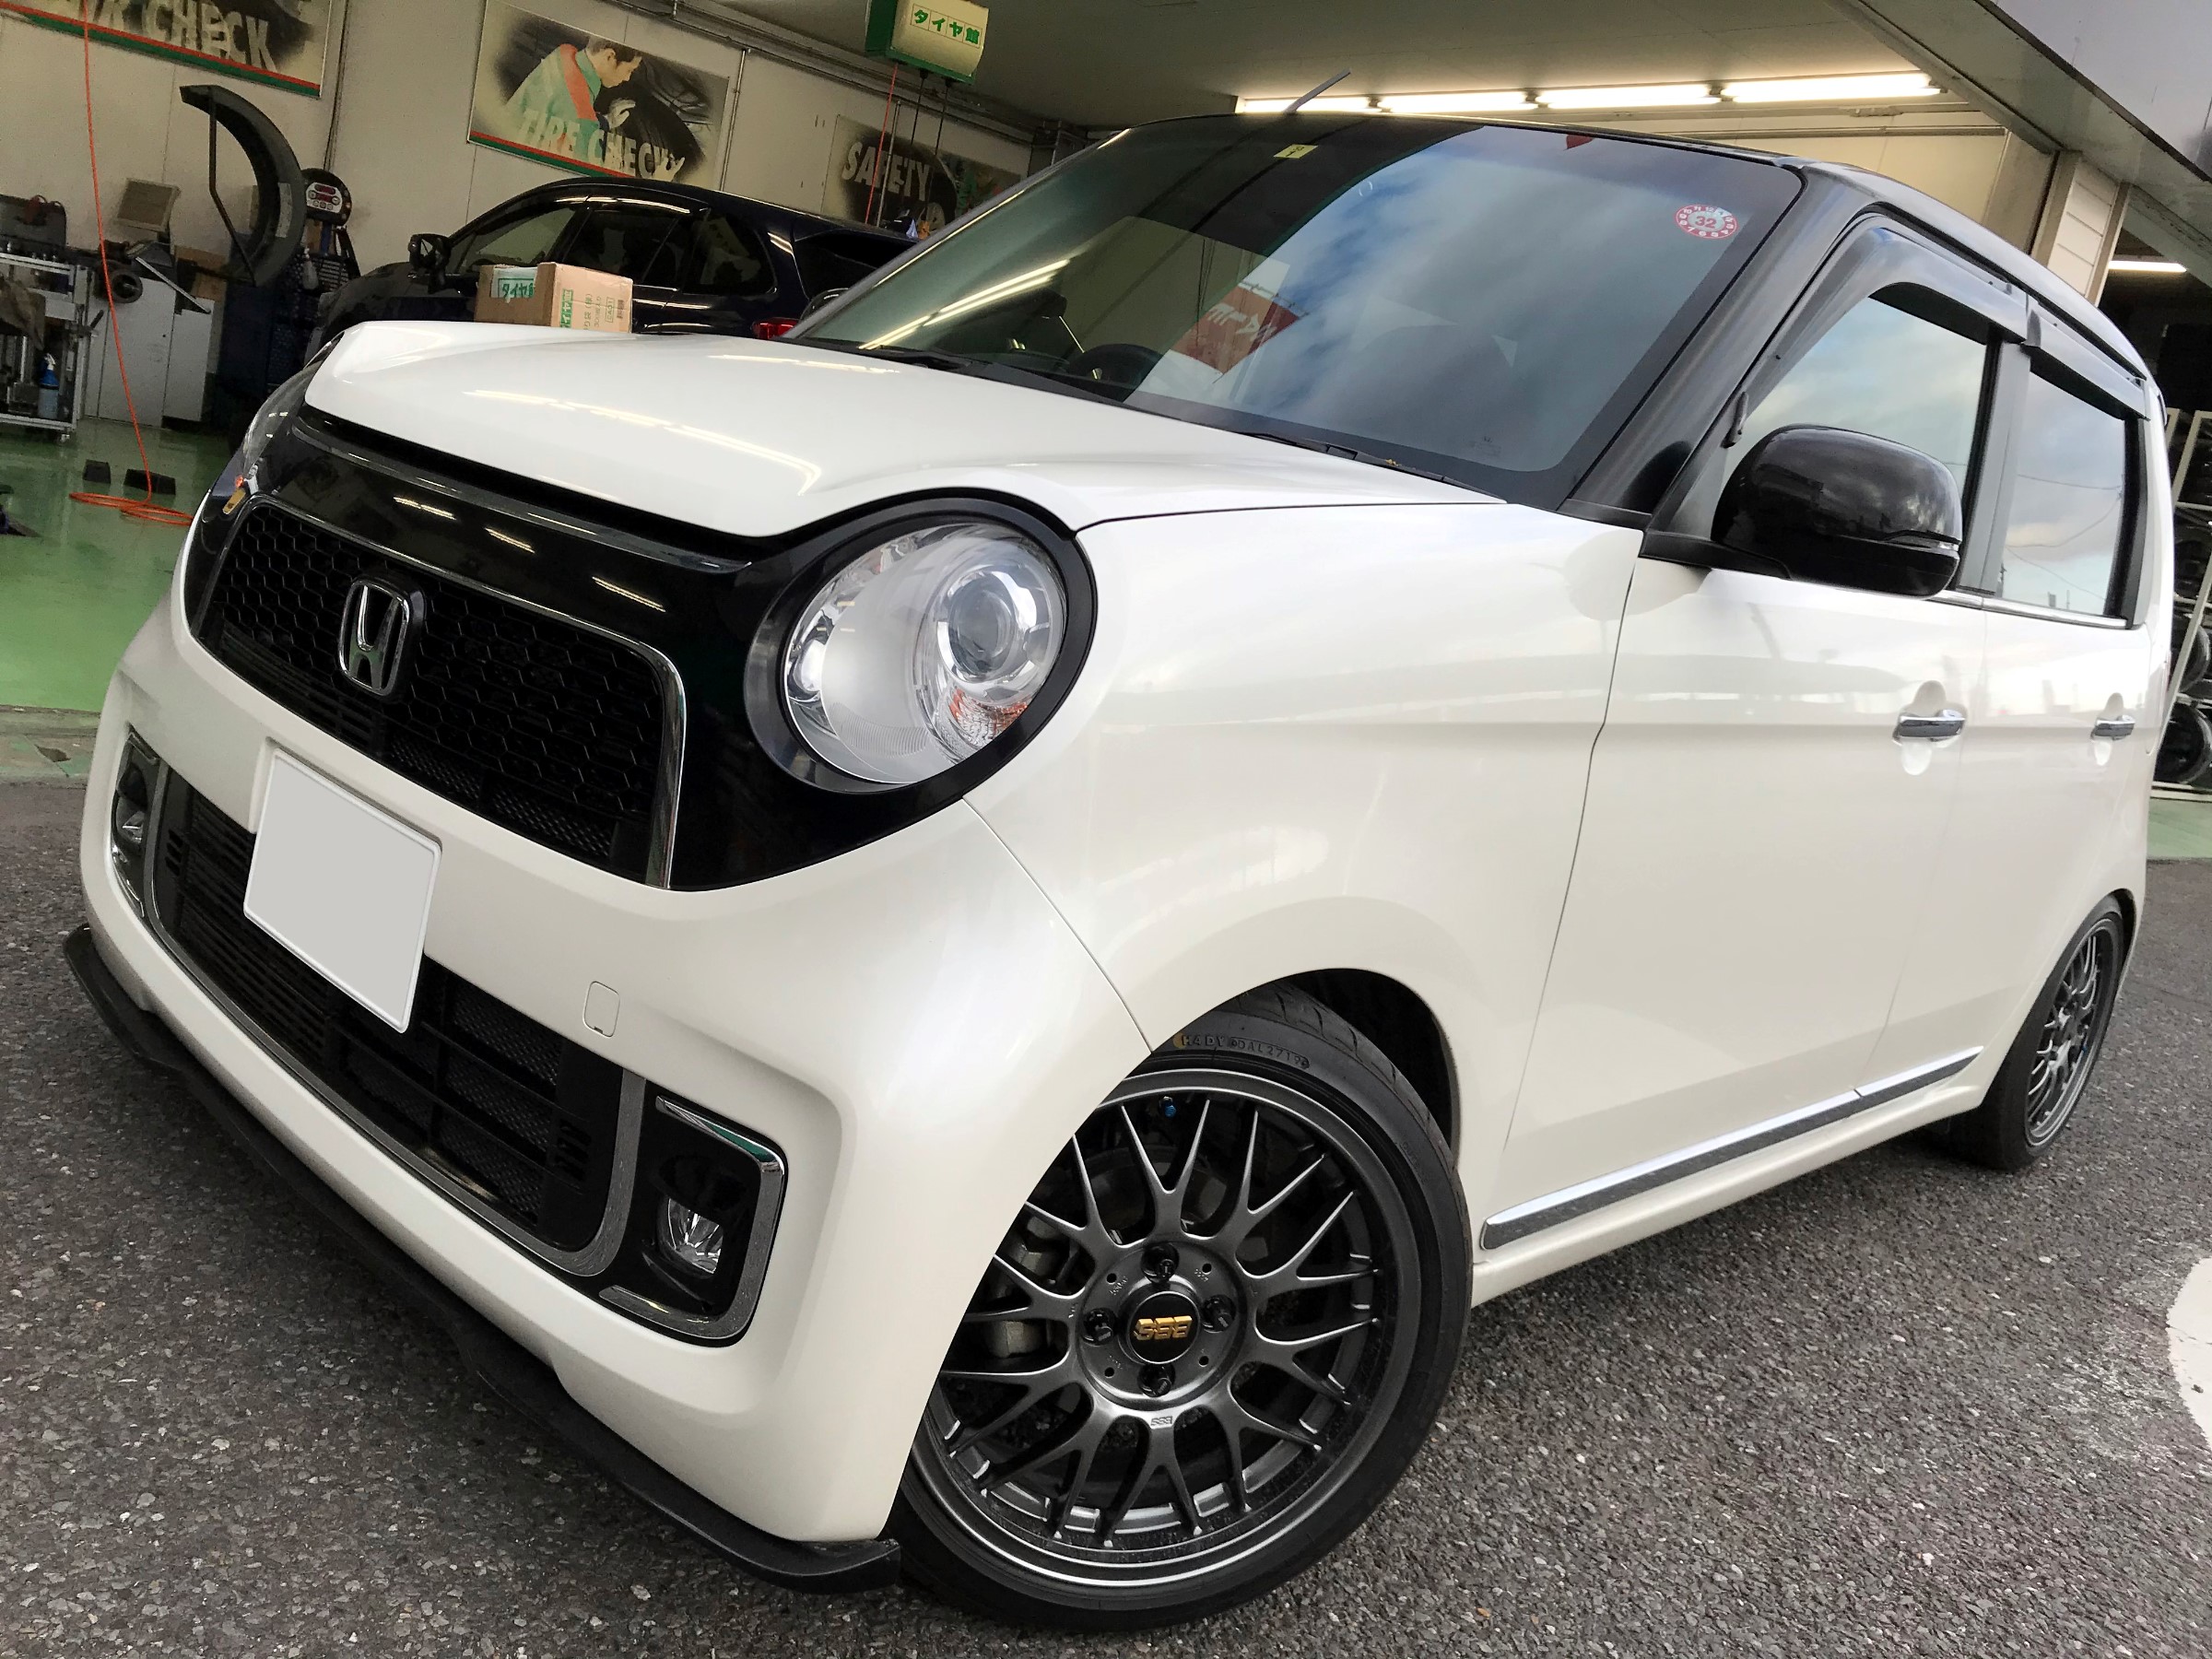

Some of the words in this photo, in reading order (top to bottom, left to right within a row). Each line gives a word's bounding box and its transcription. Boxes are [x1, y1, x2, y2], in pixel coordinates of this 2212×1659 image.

[141, 0, 277, 72] CHECK
[913, 9, 980, 45] タイヤ館
[519, 108, 581, 159] TIRE
[841, 141, 931, 202] SAFETY
[1695, 216, 1717, 229] 32
[1134, 1315, 1193, 1341] BBS
